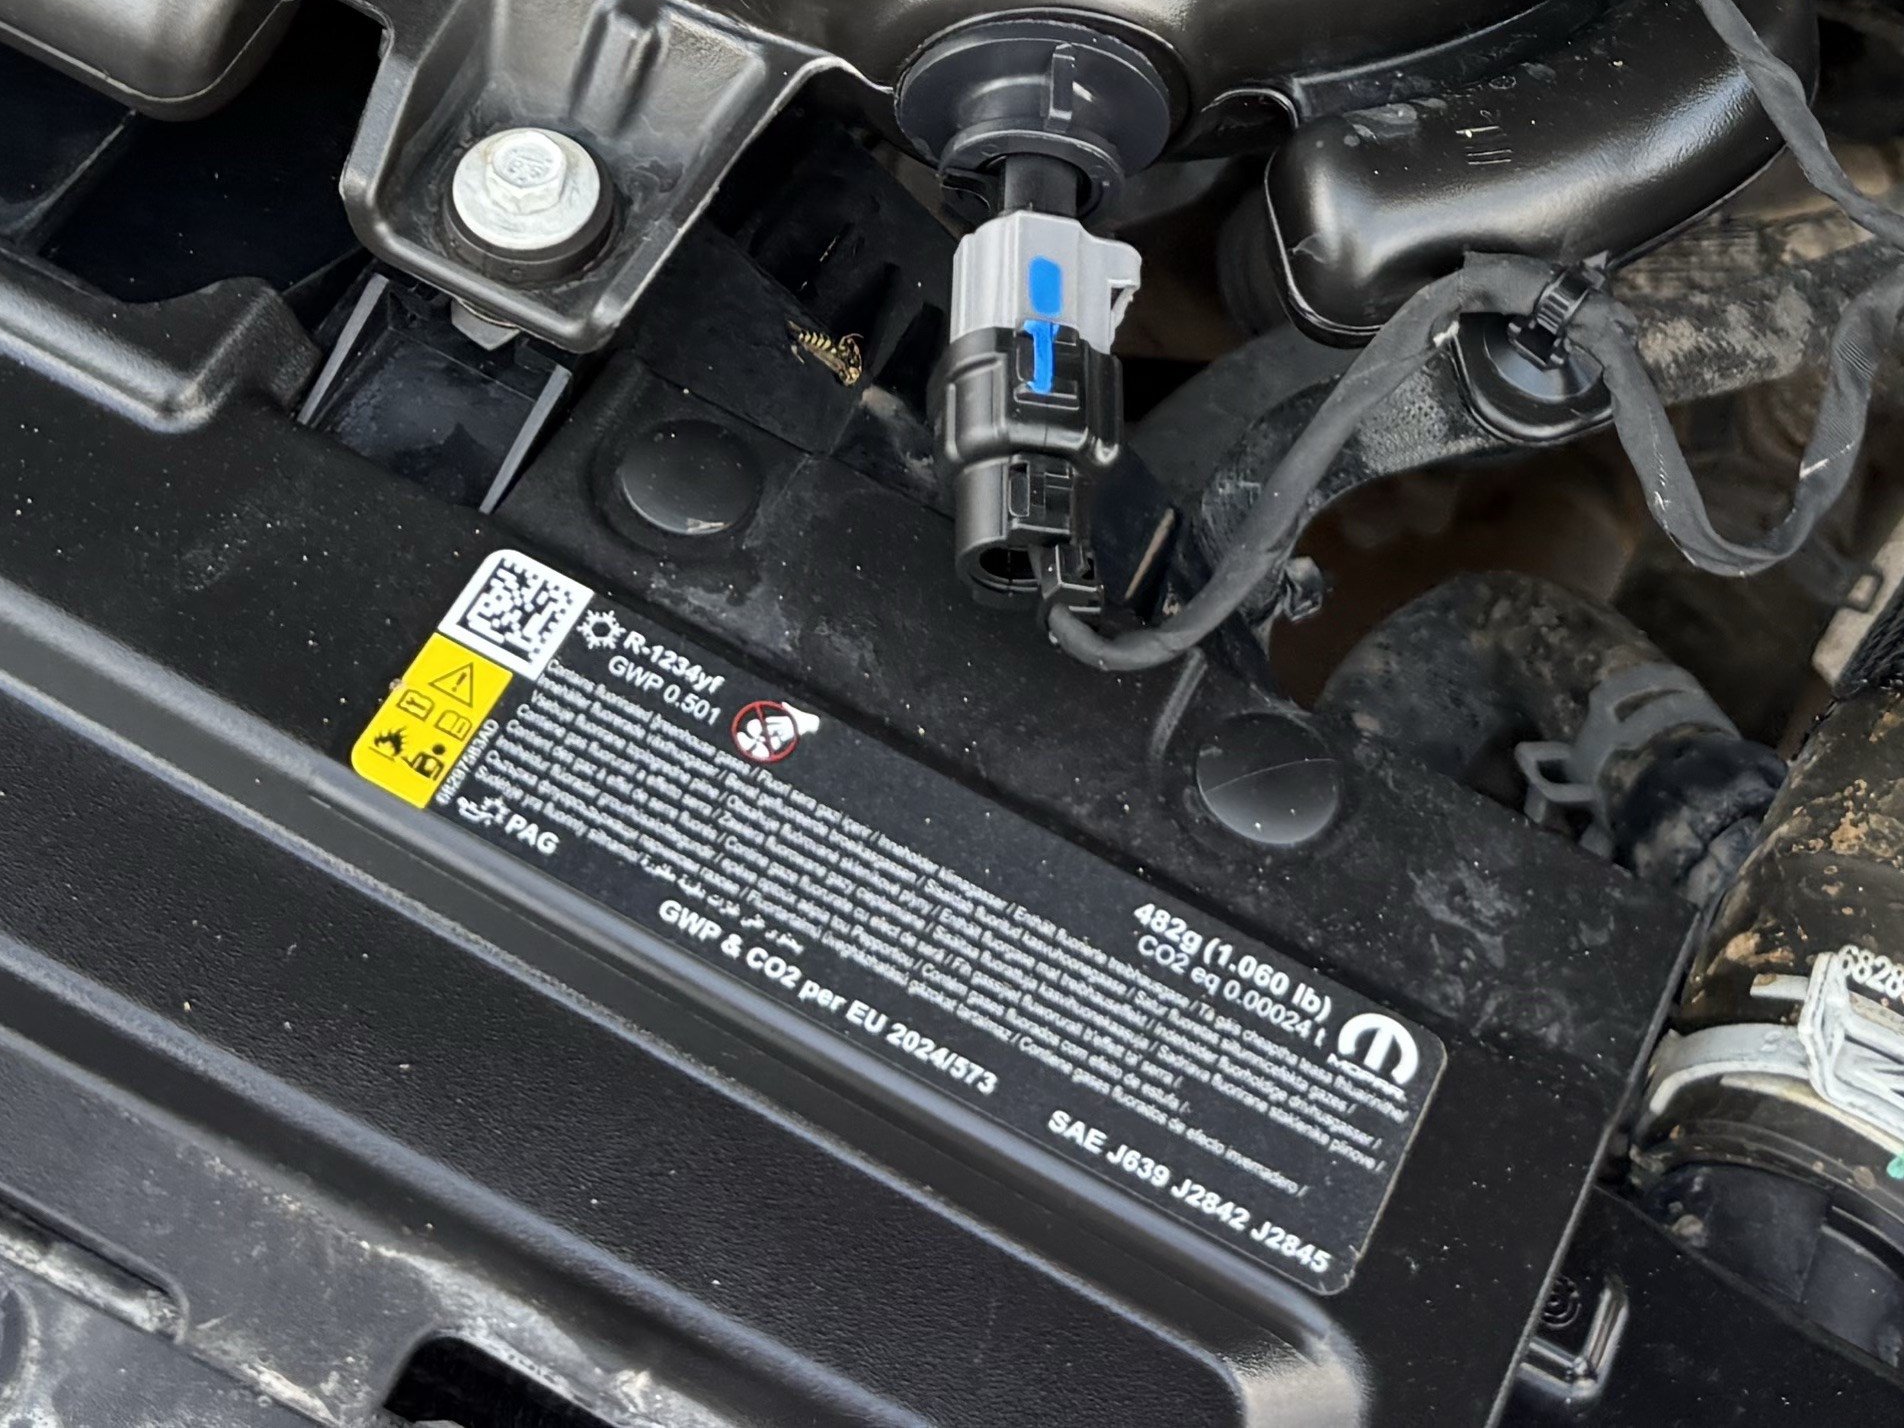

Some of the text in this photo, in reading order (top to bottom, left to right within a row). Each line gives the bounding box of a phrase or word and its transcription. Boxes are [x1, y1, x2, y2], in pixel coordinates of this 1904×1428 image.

[607, 654, 721, 725] GWP 0.501
[622, 630, 725, 693] R-1234yf
[504, 813, 559, 855] PAG
[658, 899, 997, 1094] GWP & CO2 per EU 2024/573
[1133, 903, 1332, 1023] 482g (1.060 lb)
[1137, 934, 1326, 1048] CO2 eq 0.00024 t
[1047, 1109, 1332, 1273] SAE J639 J2842 J2845
